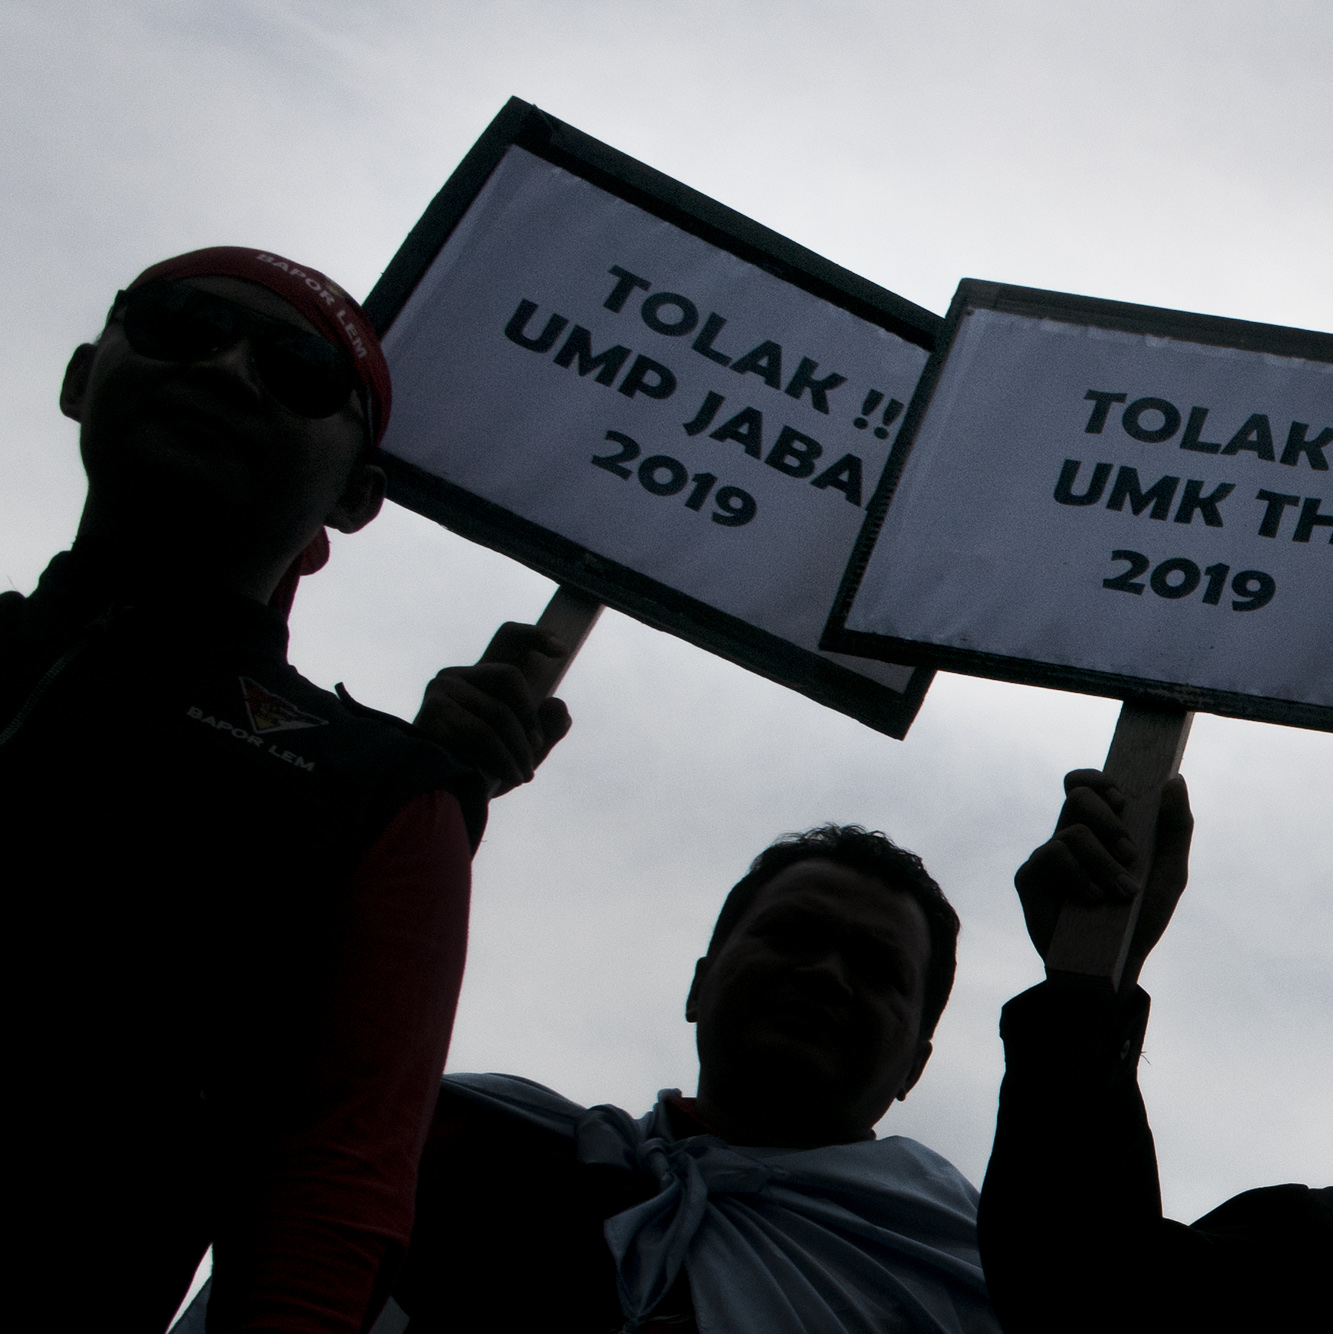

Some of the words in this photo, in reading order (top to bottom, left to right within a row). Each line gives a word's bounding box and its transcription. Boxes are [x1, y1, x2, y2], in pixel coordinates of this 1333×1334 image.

[256, 253, 336, 306] BAPOR
[336, 310, 368, 359] LEM
[604, 264, 848, 414] TOLAK
[854, 389, 904, 440] !!
[504, 299, 677, 400] UMP
[683, 391, 869, 511] JABA
[592, 430, 757, 526] 2019
[1054, 459, 1234, 529] UMK
[1103, 550, 1276, 612] 2019
[185, 704, 265, 748] BAPOR
[267, 744, 316, 773] LEM
